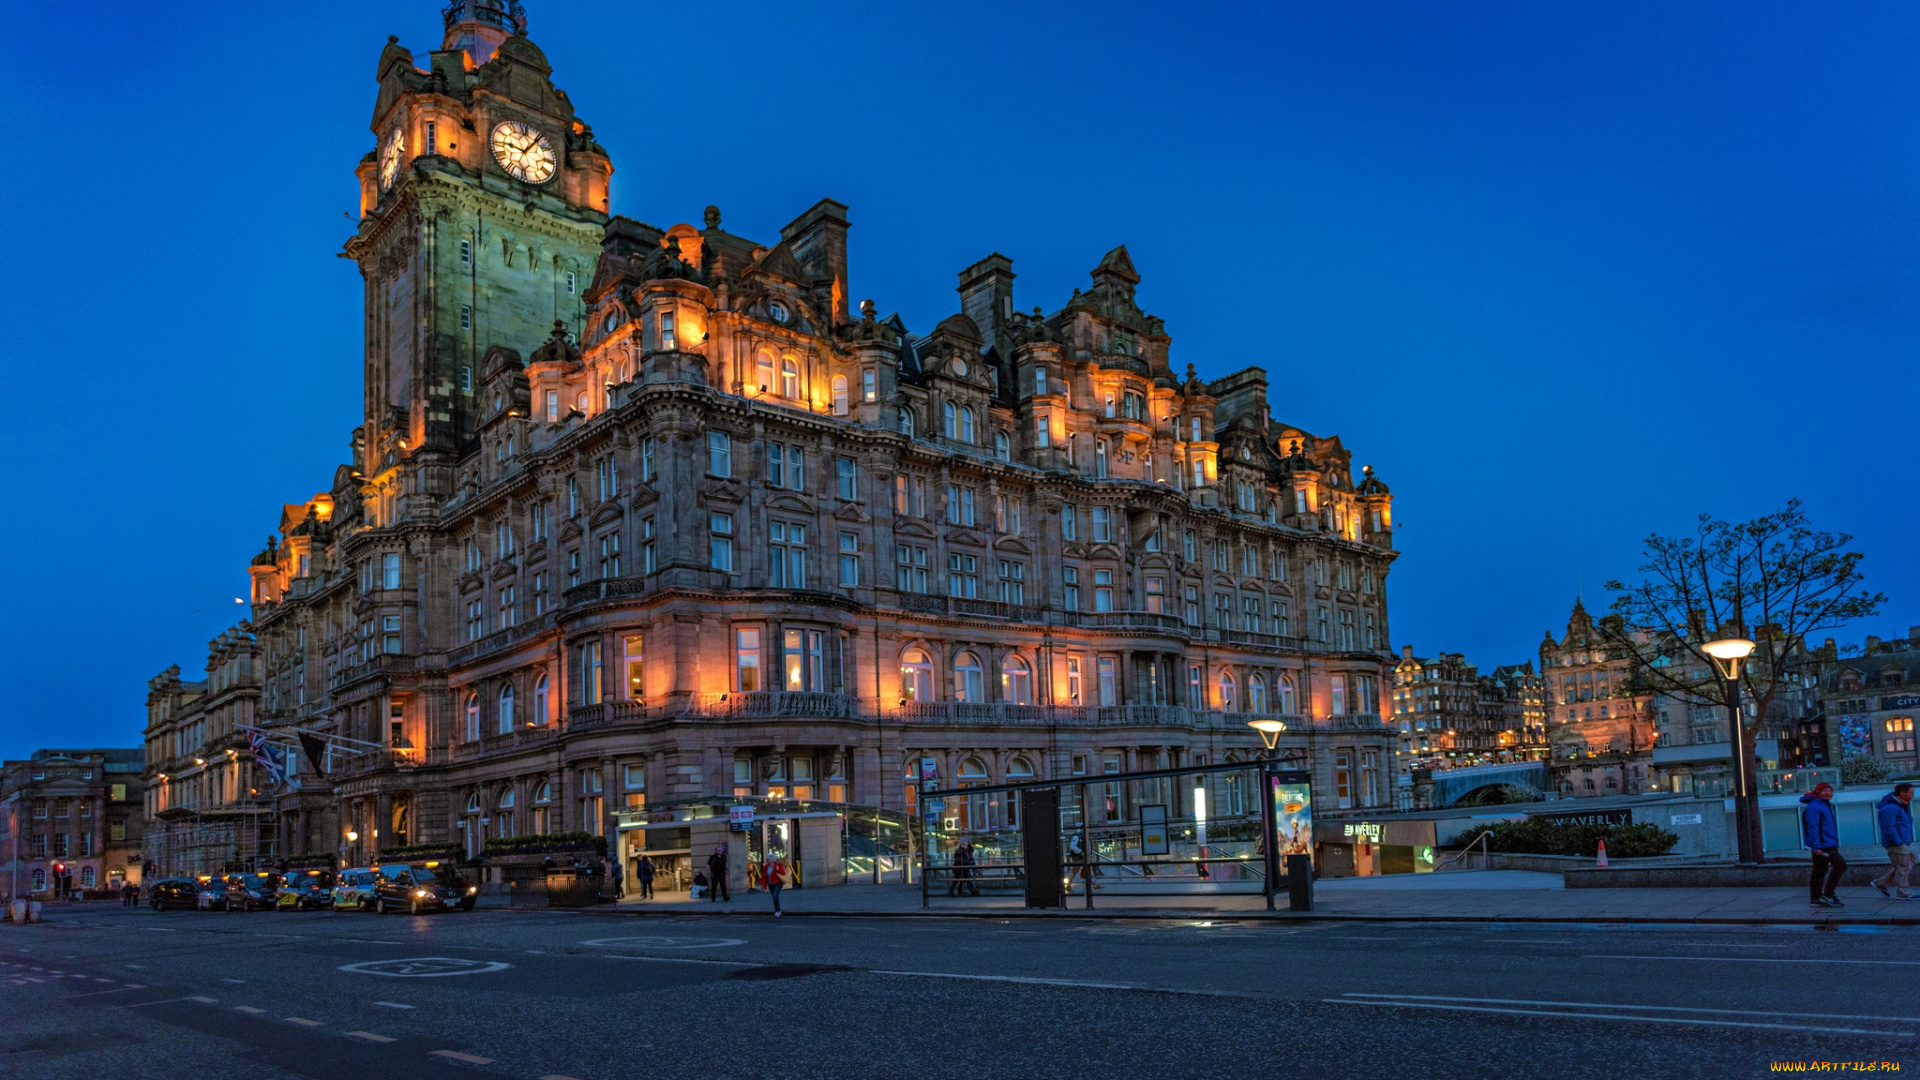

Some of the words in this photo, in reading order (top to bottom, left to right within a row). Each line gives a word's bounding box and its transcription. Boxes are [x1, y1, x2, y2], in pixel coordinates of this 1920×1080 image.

[1897, 697, 1920, 706] CITY
[1281, 793, 1304, 804] EVERYTHING
[1554, 813, 1627, 827] WAVERLY
[1349, 824, 1380, 836] WAVERLEY
